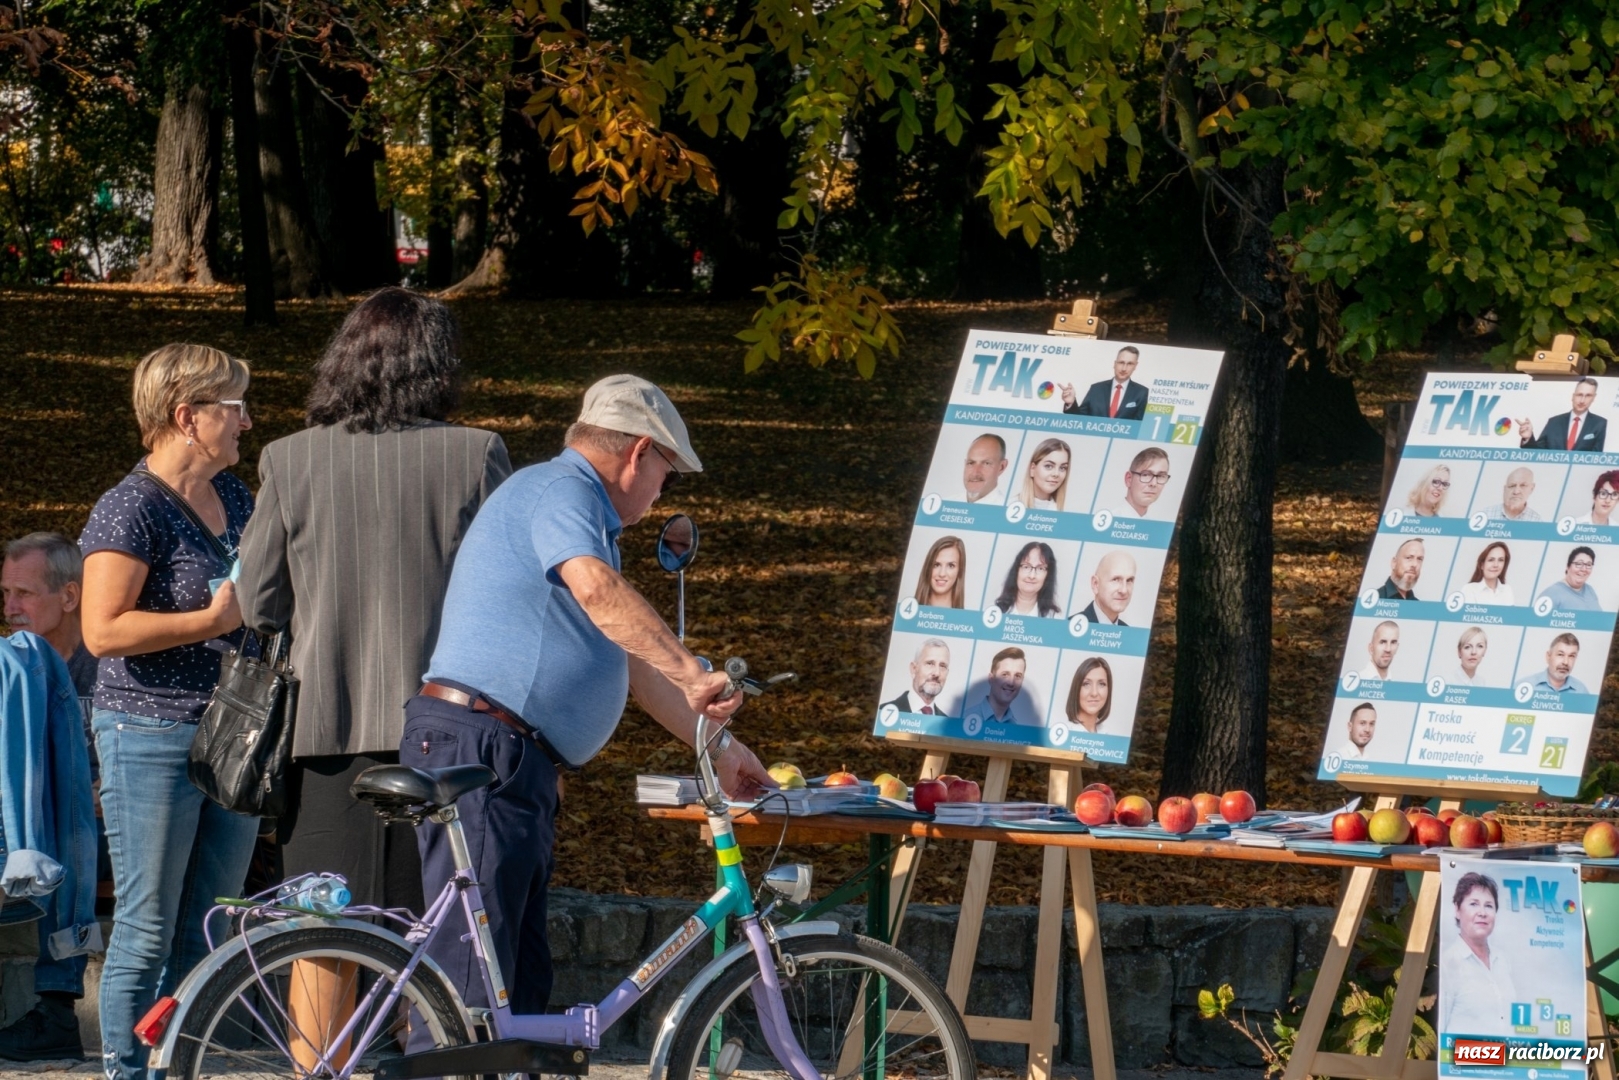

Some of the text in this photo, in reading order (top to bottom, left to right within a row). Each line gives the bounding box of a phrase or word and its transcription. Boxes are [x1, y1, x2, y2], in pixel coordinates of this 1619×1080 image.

[975, 339, 1071, 356] POWIEDZMY SOBIE
[1153, 379, 1210, 390] ROBERT MYŚLIWY
[1433, 380, 1529, 392] POWIEDZMY SOBIE
[1151, 388, 1179, 396] NASZYM
[1149, 396, 1195, 406] PREZYDENTEM
[1149, 405, 1171, 414] OKRĘG
[954, 410, 1132, 434] KANDYDACI DO RADY MIASTA RACIBÓRZ
[1151, 416, 1162, 440] 1
[1173, 423, 1196, 444] 21
[1439, 448, 1618, 466] KANDYDACI DO RADY MIASTA RACIBÓRZ
[928, 498, 935, 511] 1
[941, 505, 969, 515] Ireneusz
[1010, 506, 1021, 520] 2
[1027, 513, 1058, 524] Adrianna
[1390, 512, 1398, 525] 1
[939, 514, 975, 525] CIESIELSKI
[1096, 514, 1107, 528] 3
[1403, 517, 1421, 525] Anna
[1474, 515, 1484, 529] 2
[1025, 523, 1054, 533] CZOPEK
[1113, 521, 1136, 531] Robert
[1400, 525, 1442, 535] BRACHMAN
[1487, 521, 1506, 532] Jerzy
[1561, 520, 1572, 534] 3
[1576, 524, 1597, 534] Marta
[1110, 530, 1149, 541] KOZIARSKI
[1484, 530, 1512, 540] DĘBINA
[1573, 533, 1612, 543] GAWENDA
[1364, 594, 1373, 608] 4
[1377, 600, 1400, 609] Marcin
[1449, 595, 1460, 609] 5
[1537, 599, 1547, 614] 6
[903, 601, 913, 615] 4
[1373, 609, 1398, 618] JANUS
[1464, 604, 1488, 614] Sabina
[1552, 609, 1576, 619] Dorota
[918, 611, 945, 621] Barbara
[987, 610, 997, 624] 5
[1004, 616, 1024, 626] Beata
[1462, 614, 1503, 625] KLIMASZKA
[916, 620, 974, 633] MODRZEJEWSKA
[1073, 618, 1083, 633] 6
[1550, 619, 1576, 629] KLIMEK
[1001, 632, 1043, 645] JASZEWSKA
[1090, 629, 1122, 640] Krzysztof
[1088, 637, 1122, 650] MYŚLIWY
[1347, 675, 1357, 689] 7
[1431, 680, 1440, 694] 8
[1358, 690, 1386, 700] MICZEK
[1446, 686, 1471, 696] Joanna
[1519, 686, 1529, 701] 9
[1533, 691, 1561, 703] Andrzej
[1444, 695, 1467, 705] RASEK
[1531, 701, 1564, 712] ŚLIWICKI
[886, 709, 895, 723] 7
[1428, 710, 1462, 724] Troska
[1509, 715, 1533, 724] OKRĘG
[900, 718, 922, 728] Witold
[969, 717, 978, 731] 8
[985, 726, 1006, 737] Daniel
[1054, 727, 1064, 742] 9
[1423, 728, 1477, 744] Aktywność
[1071, 736, 1105, 748] Katarzyna
[1507, 726, 1526, 753] 2
[1418, 748, 1484, 765] Kompetencje
[1541, 746, 1565, 768] 21
[1326, 756, 1340, 770] 10
[1343, 761, 1369, 771] Szymon
[1518, 1005, 1524, 1025] 1
[1543, 1005, 1551, 1020] 3
[1557, 1020, 1570, 1035] 18
